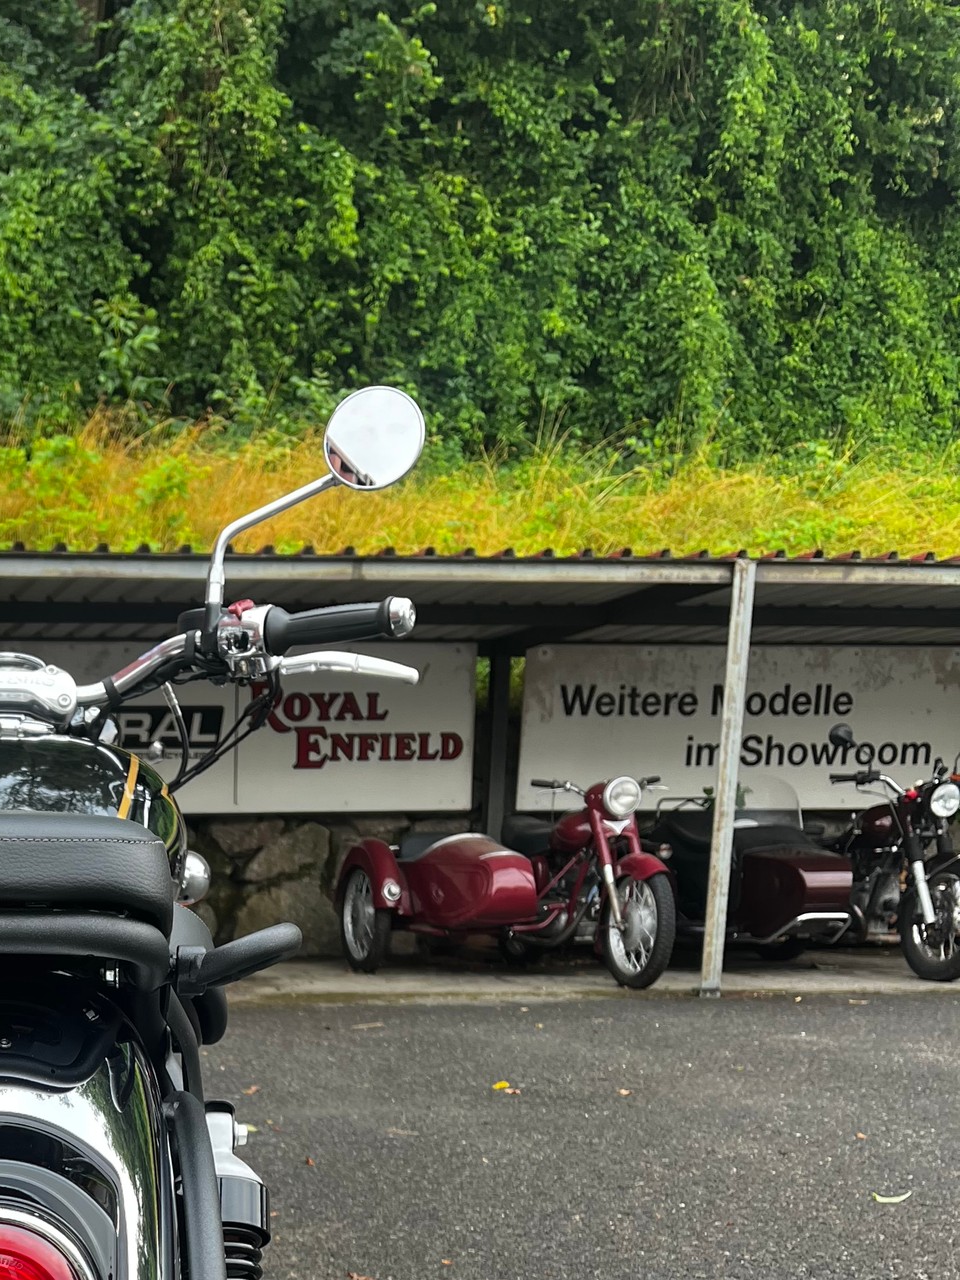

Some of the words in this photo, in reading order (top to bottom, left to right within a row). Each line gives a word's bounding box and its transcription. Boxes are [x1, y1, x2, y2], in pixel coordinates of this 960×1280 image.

[249, 681, 389, 733] ROYAL
[560, 684, 699, 716] Weitere
[119, 712, 218, 742] RAL
[293, 726, 464, 769] ENFIELD
[739, 734, 932, 767] Showroom
